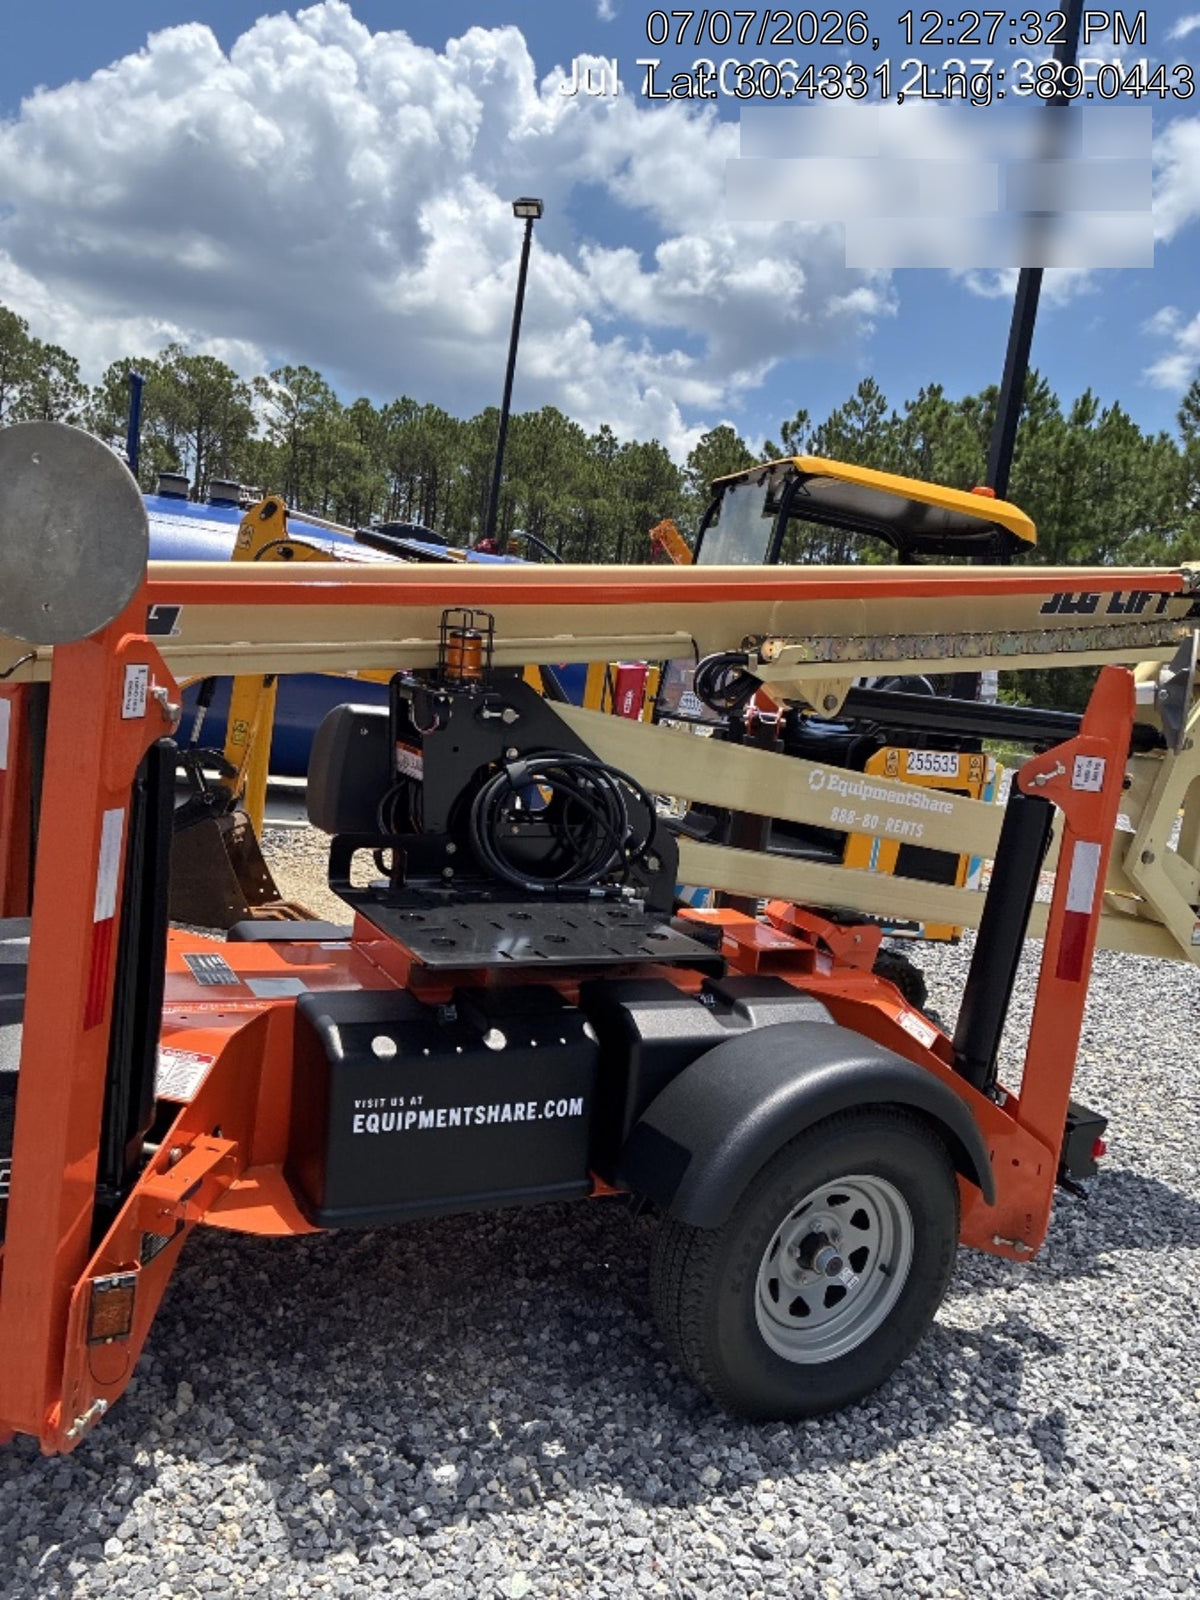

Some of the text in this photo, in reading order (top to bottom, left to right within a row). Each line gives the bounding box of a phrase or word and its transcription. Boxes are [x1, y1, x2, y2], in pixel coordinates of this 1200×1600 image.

[907, 751, 958, 773] 255535
[826, 773, 954, 815] EquipmentShare
[352, 1097, 585, 1135] EQUIPMENTSHARE.COM
[354, 1095, 424, 1109] VISIT US AT
